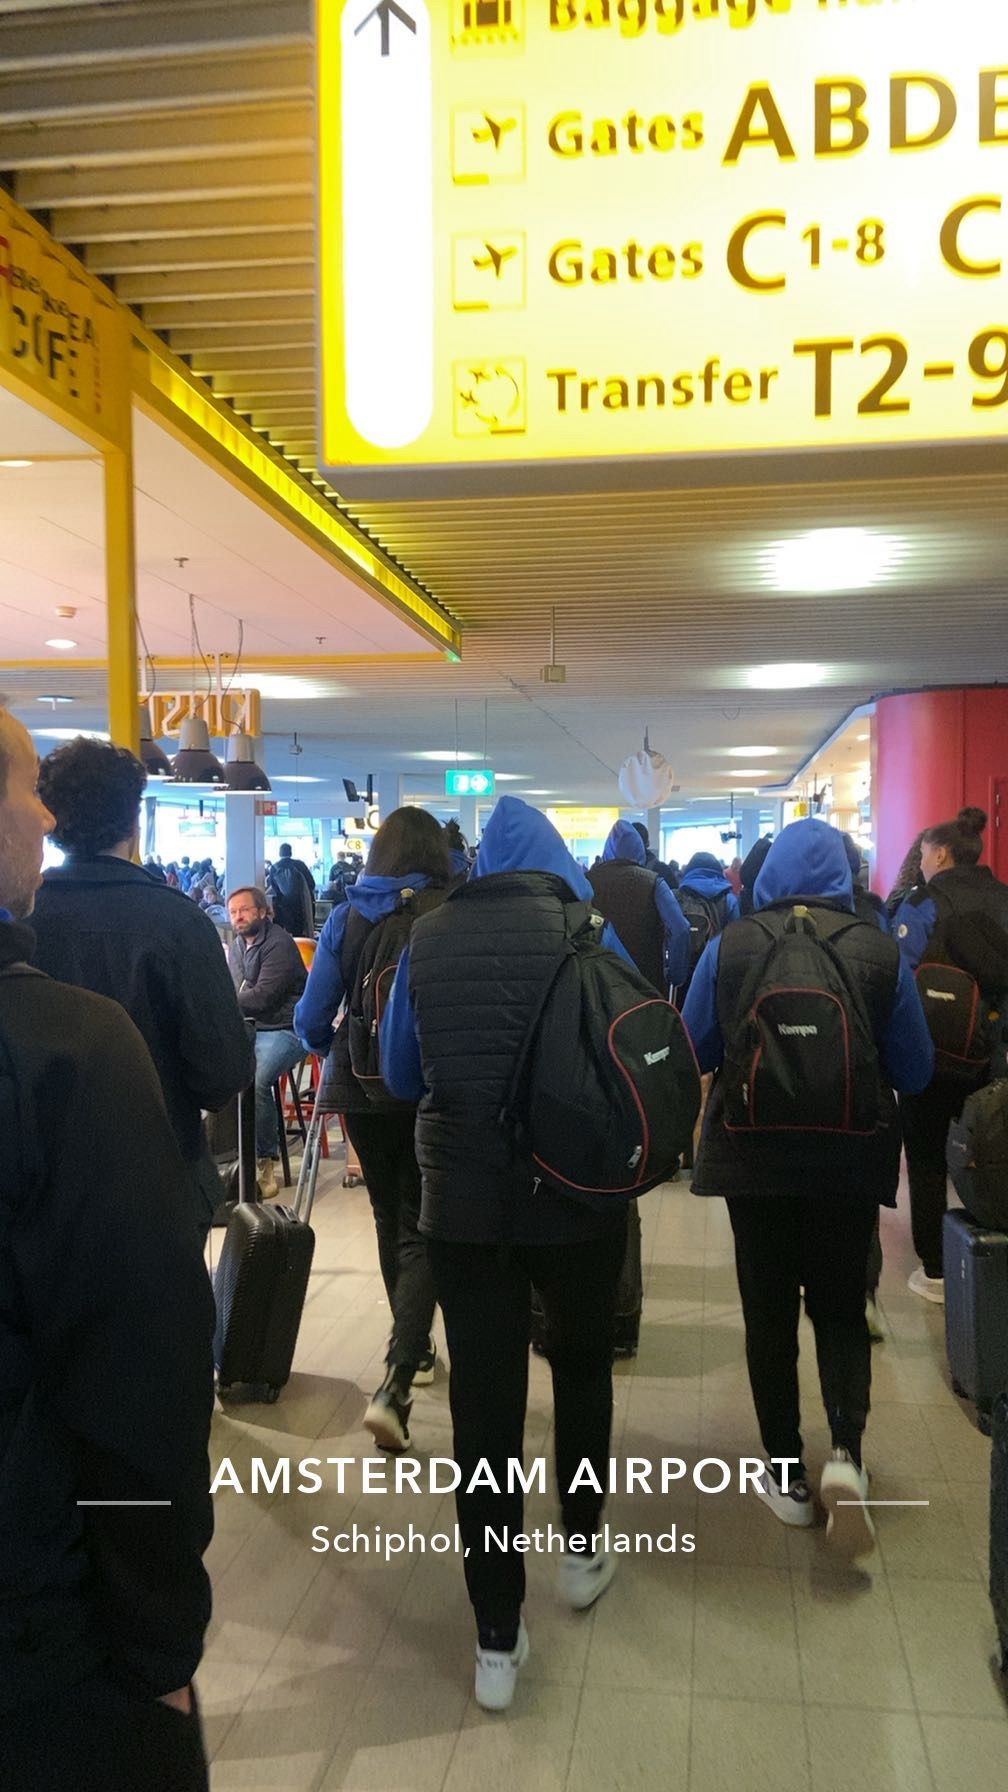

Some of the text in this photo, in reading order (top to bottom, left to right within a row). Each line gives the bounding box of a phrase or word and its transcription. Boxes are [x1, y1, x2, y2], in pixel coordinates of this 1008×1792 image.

[548, 110, 705, 159] Gates
[548, 239, 704, 288] Gates
[546, 323, 1008, 420] Transfer T2-9
[643, 1045, 670, 1066] Kemp
